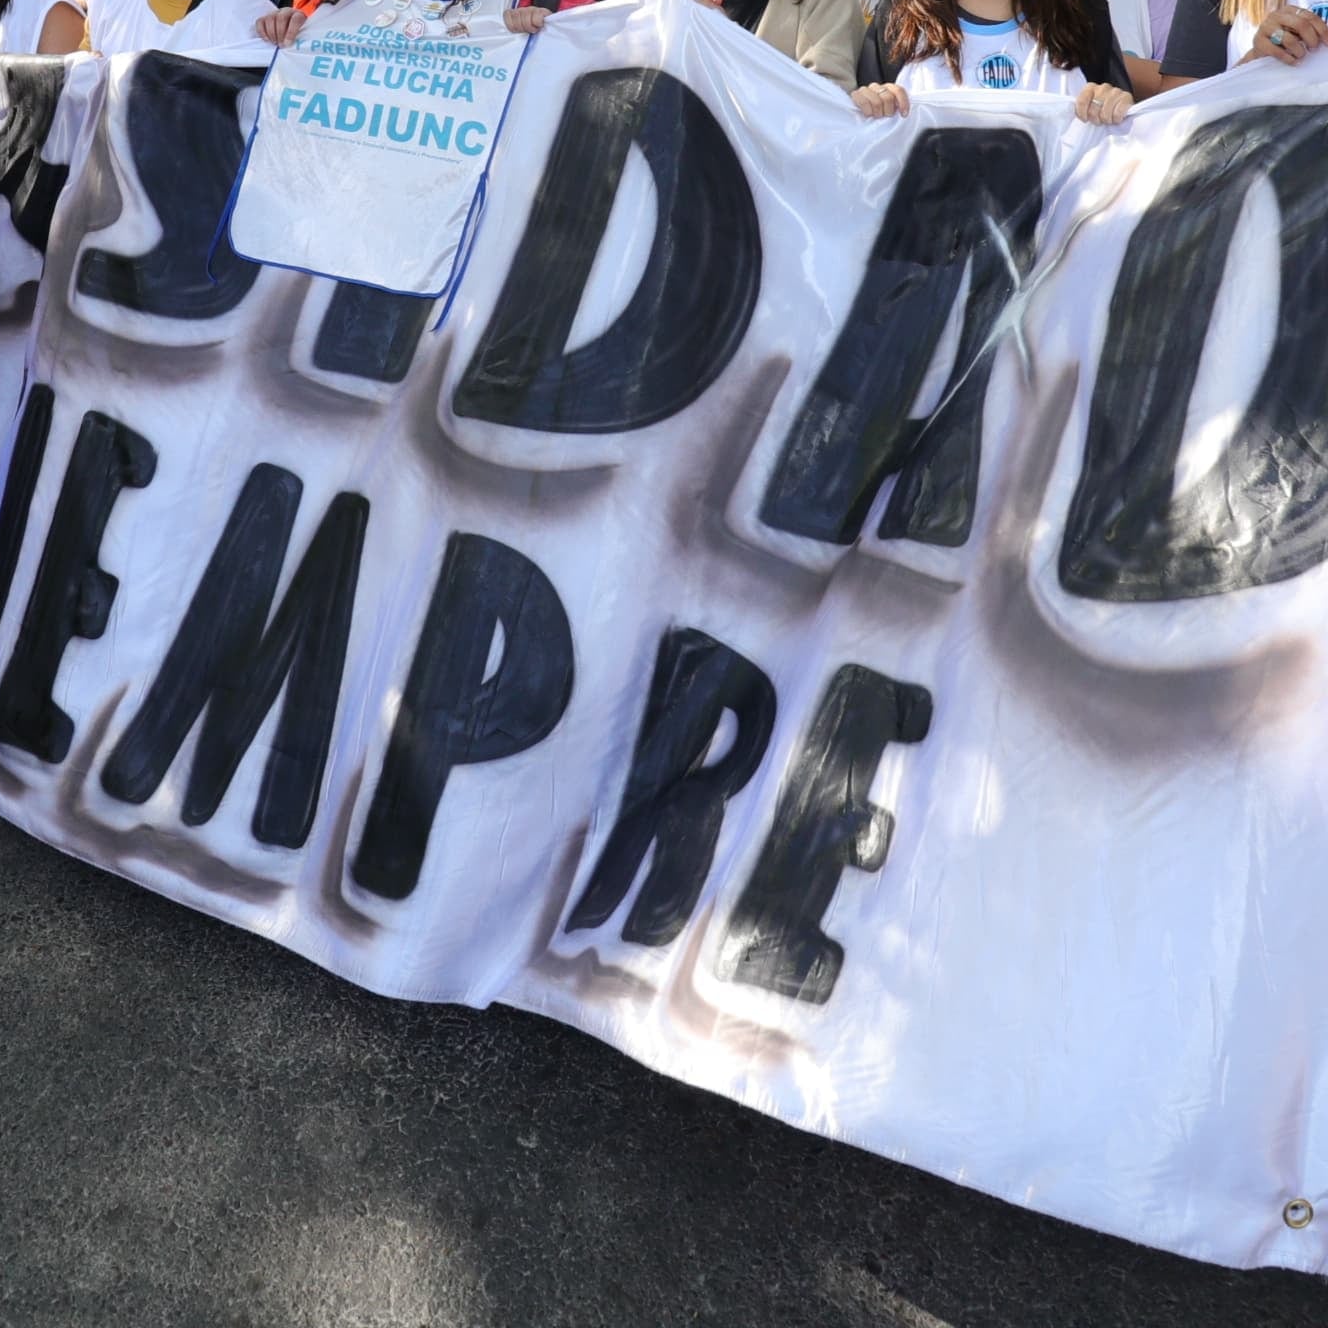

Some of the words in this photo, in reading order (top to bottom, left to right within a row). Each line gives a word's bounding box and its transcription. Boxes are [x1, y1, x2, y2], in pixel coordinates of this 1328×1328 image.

[309, 55, 356, 82] EN
[363, 62, 474, 103] LUCHA
[310, 39, 509, 83] PREUNIVERSITARIOS
[982, 56, 1016, 89] FATUN
[276, 87, 488, 157] FADIUNC
